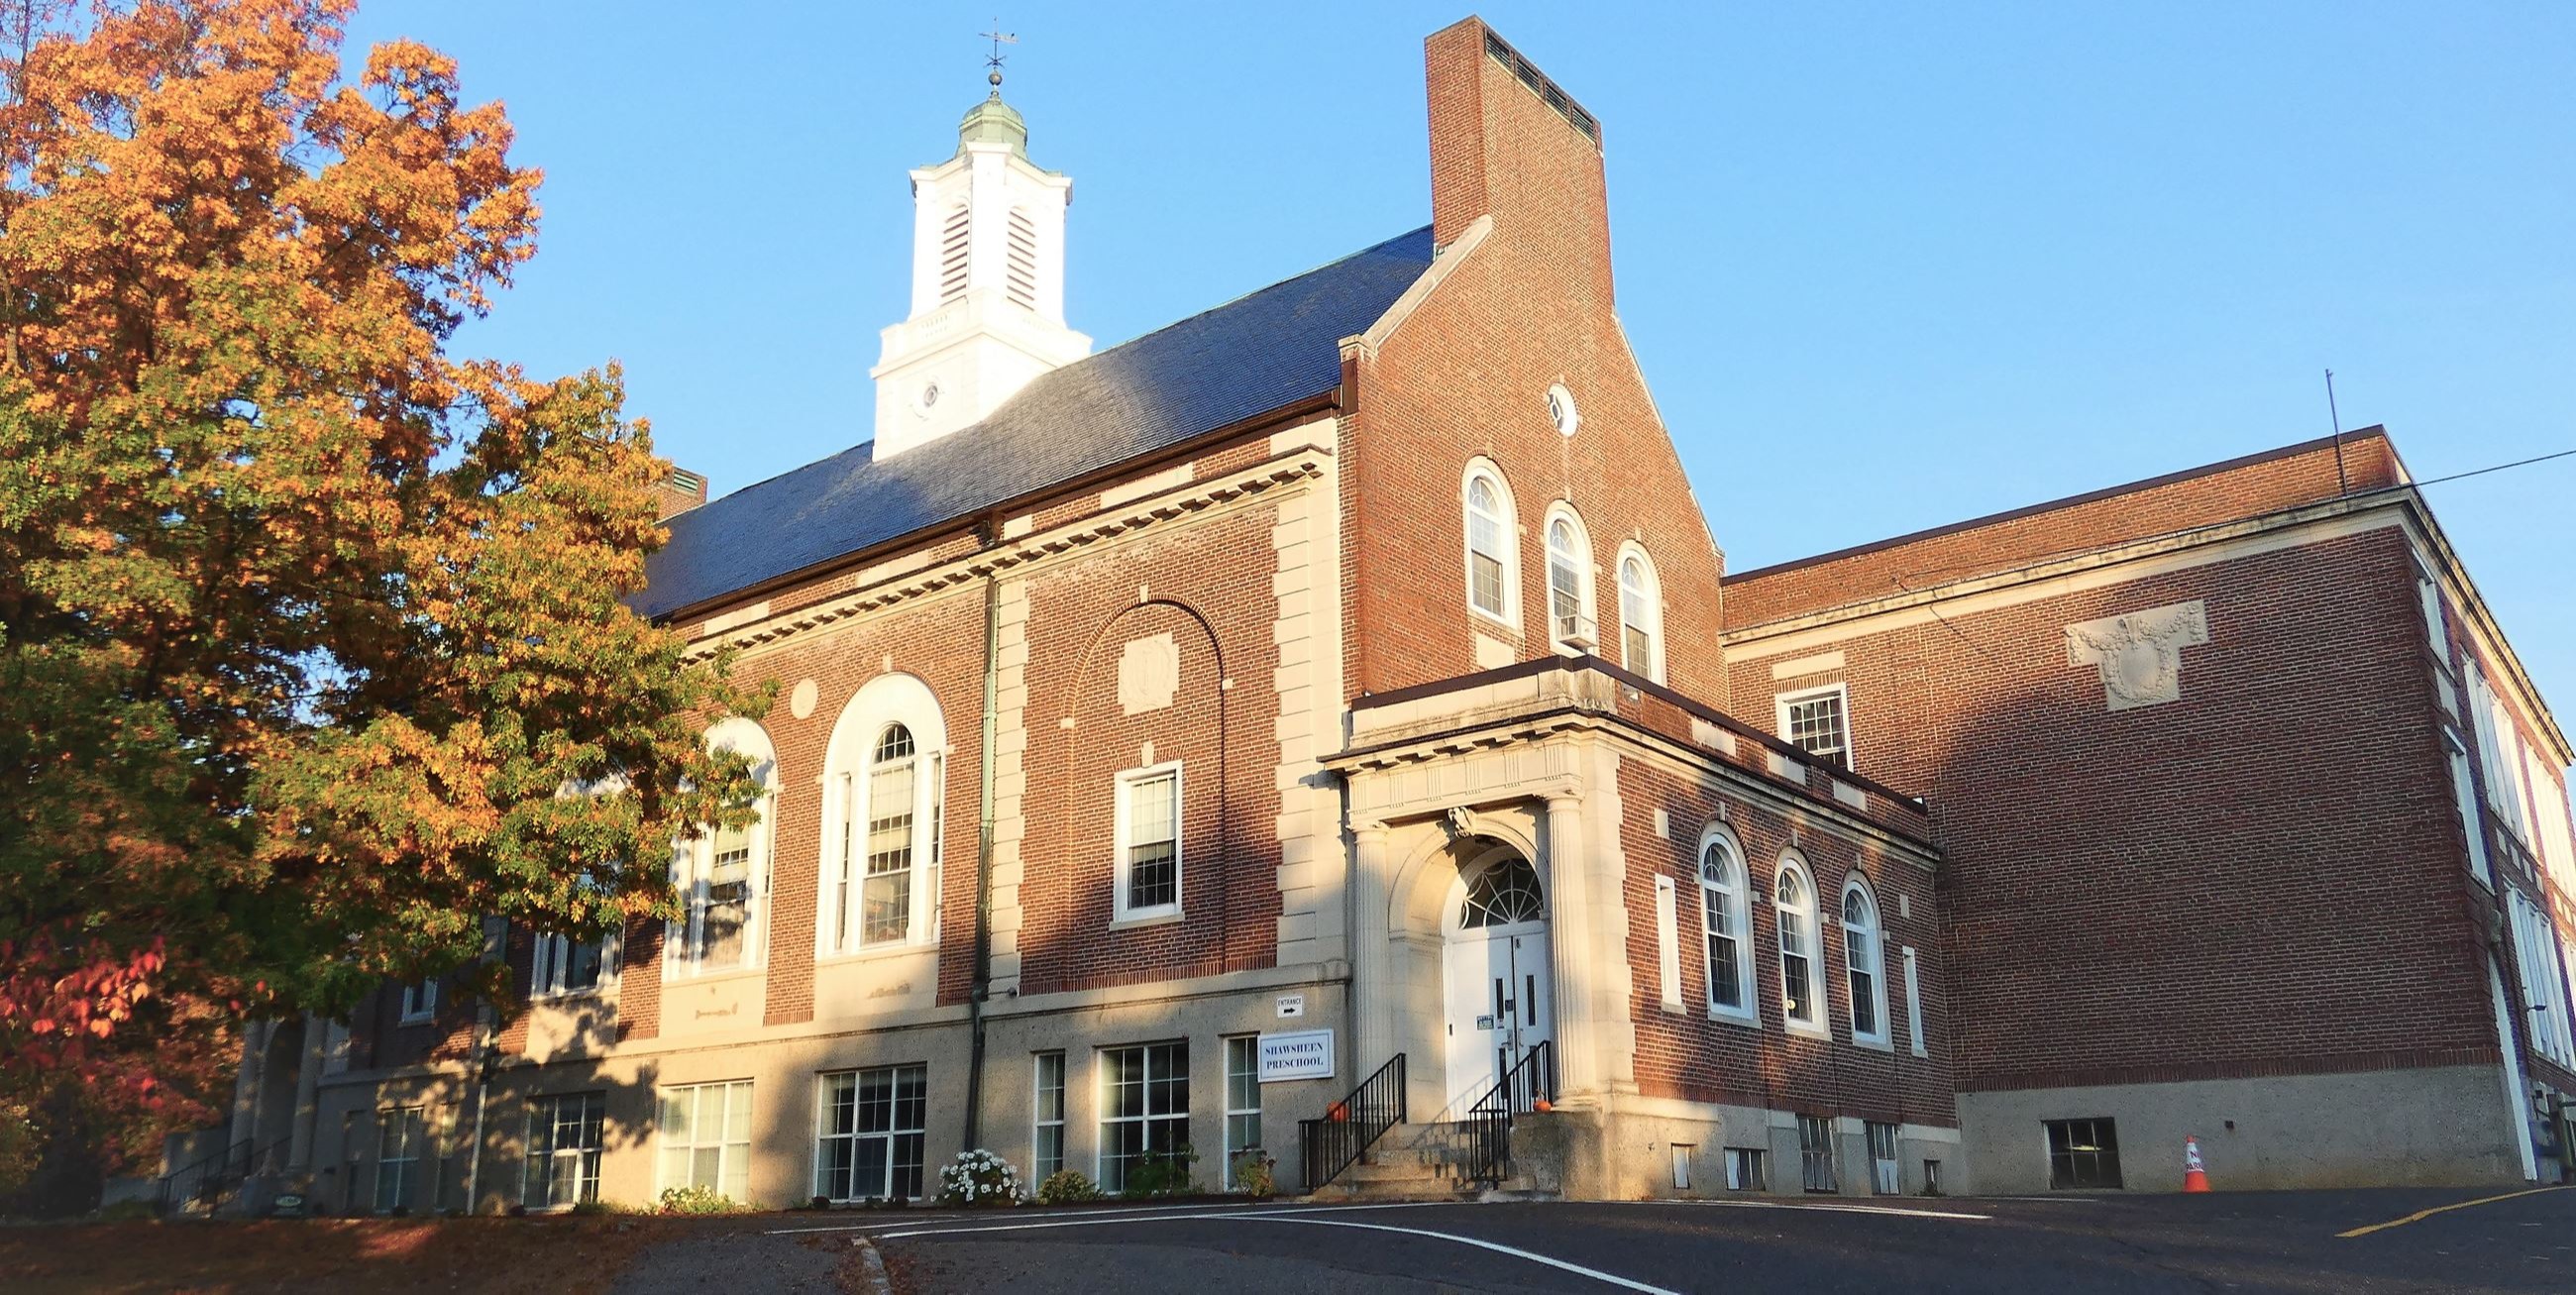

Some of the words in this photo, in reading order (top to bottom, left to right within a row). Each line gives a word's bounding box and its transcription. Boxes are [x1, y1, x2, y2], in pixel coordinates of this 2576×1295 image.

[1278, 998, 1301, 1007] ENTRANCE
[1265, 1042, 1323, 1055] SHAWSHEEN
[1266, 1057, 1323, 1070] PRESCHOOL
